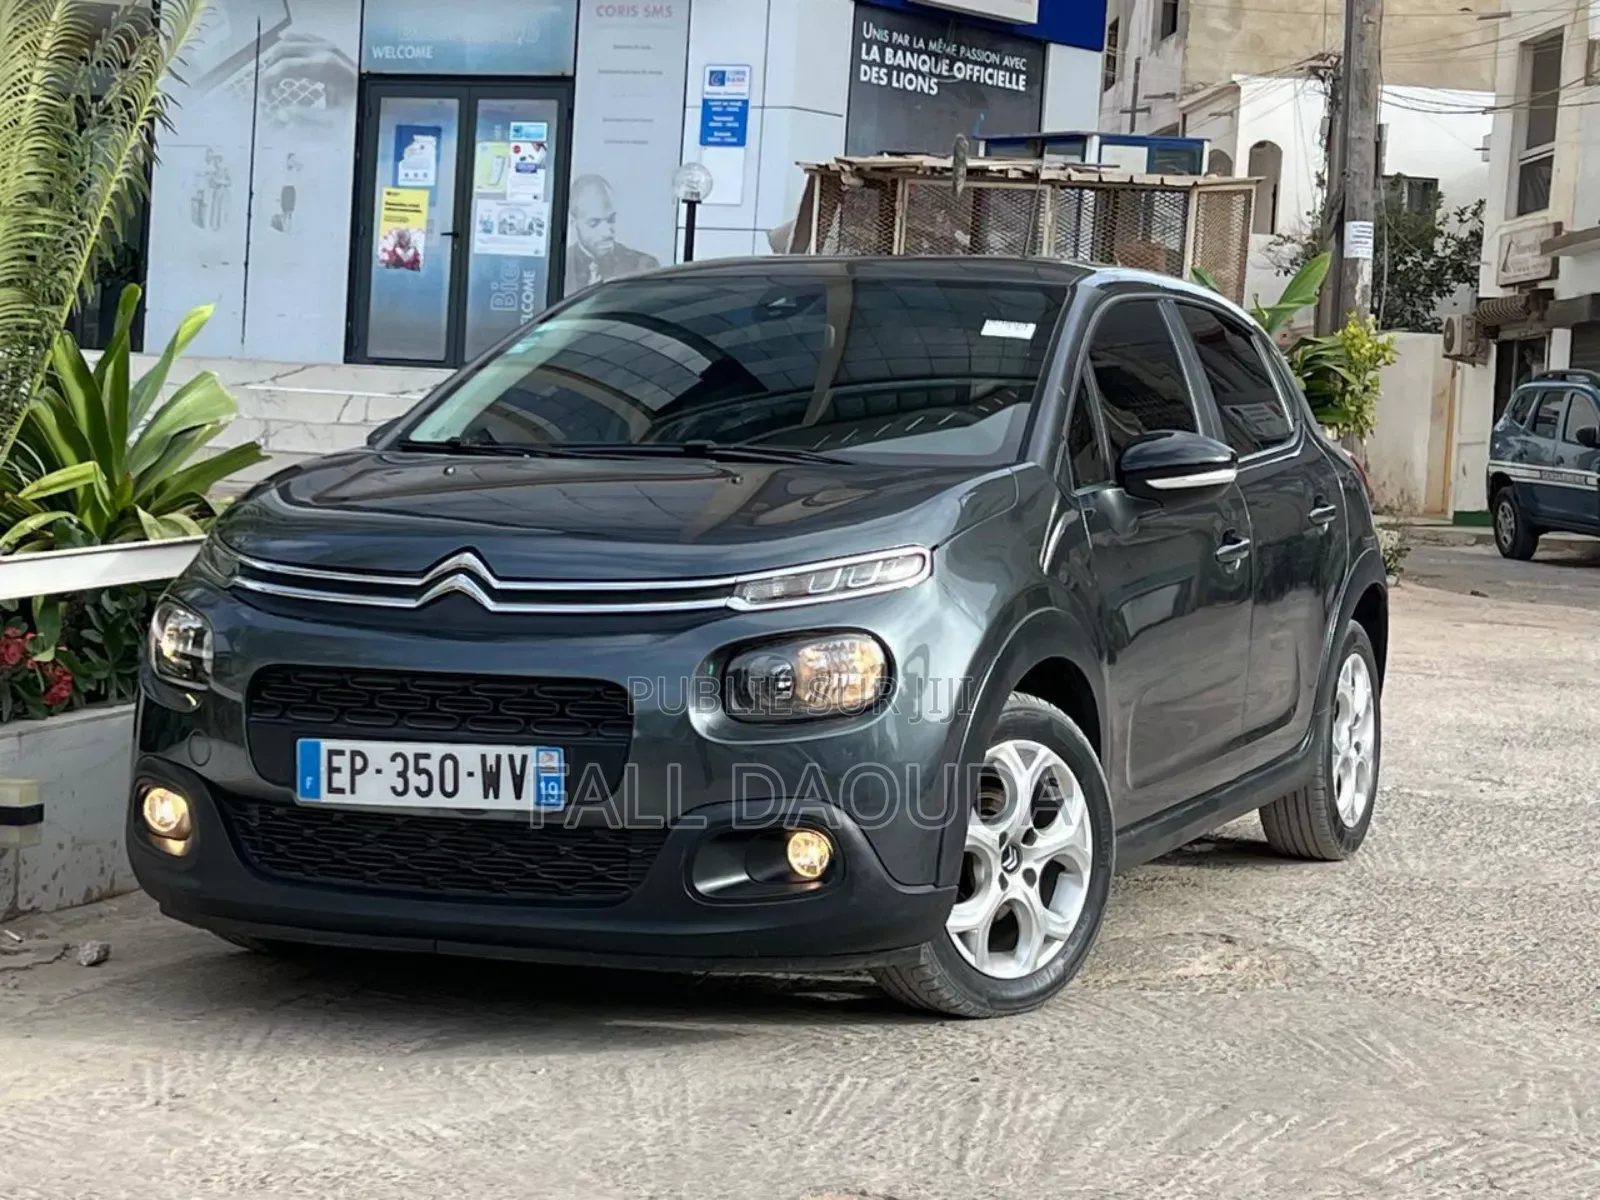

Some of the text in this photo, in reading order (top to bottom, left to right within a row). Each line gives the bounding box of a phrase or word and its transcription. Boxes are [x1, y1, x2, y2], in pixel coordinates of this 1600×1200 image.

[596, 4, 673, 19] CORIS SMS
[371, 45, 434, 60] WELCOME
[861, 42, 1027, 92] LA BANQUE OFFICIELLE
[892, 31, 910, 47] PAR
[913, 36, 925, 50] LA
[960, 45, 1000, 65] PASSION
[1002, 55, 1027, 71] AVEC
[860, 64, 938, 96] DES LIONS
[327, 749, 528, 801] EP-350-WV
